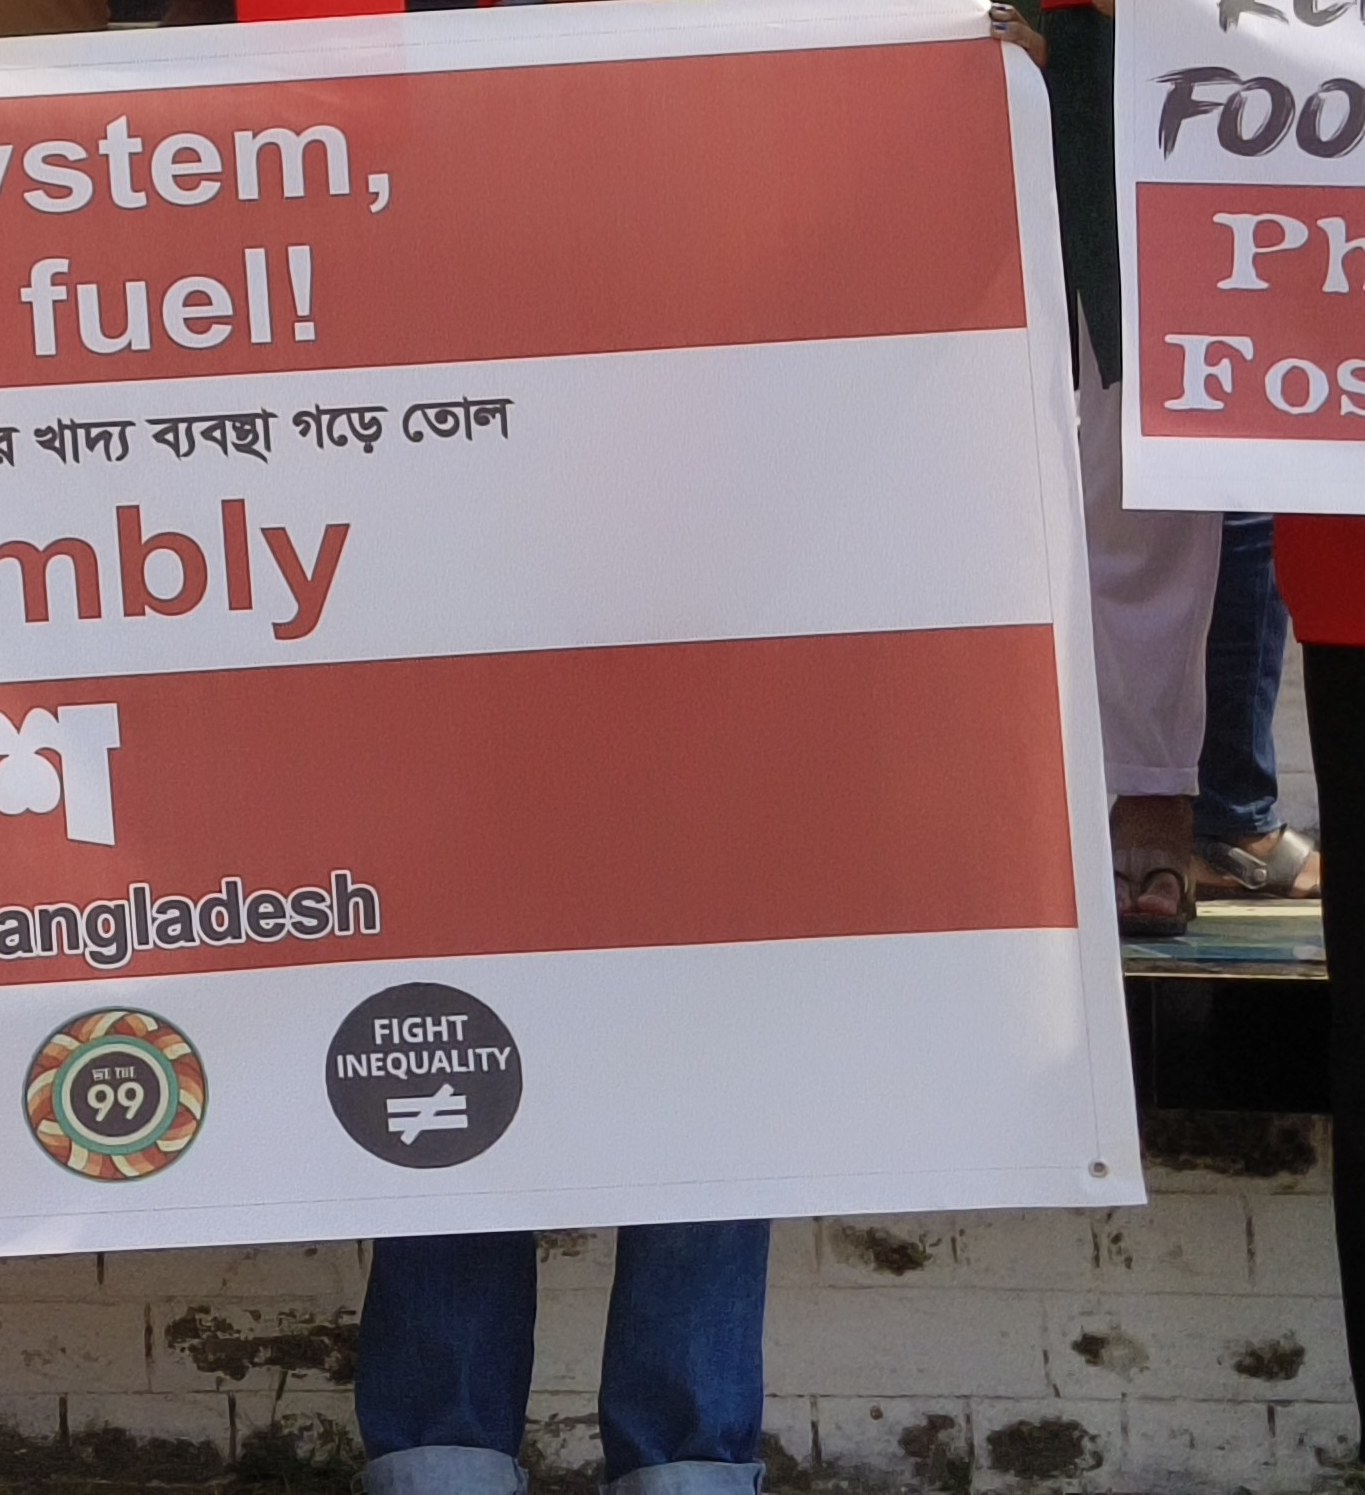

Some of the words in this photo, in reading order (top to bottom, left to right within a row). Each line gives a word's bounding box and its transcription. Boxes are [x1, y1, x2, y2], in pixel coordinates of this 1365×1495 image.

[1146, 66, 1365, 161] FOO
[20, 243, 319, 359] fuel!
[34, 417, 135, 465] খাদ্য
[145, 408, 279, 465] ব্যবস্থা
[292, 403, 389, 454] গড়ে
[402, 395, 515, 443] তোল
[374, 1015, 469, 1045] FIGHT
[337, 1046, 512, 1080] INEQUALITY
[87, 1081, 144, 1122] 99
